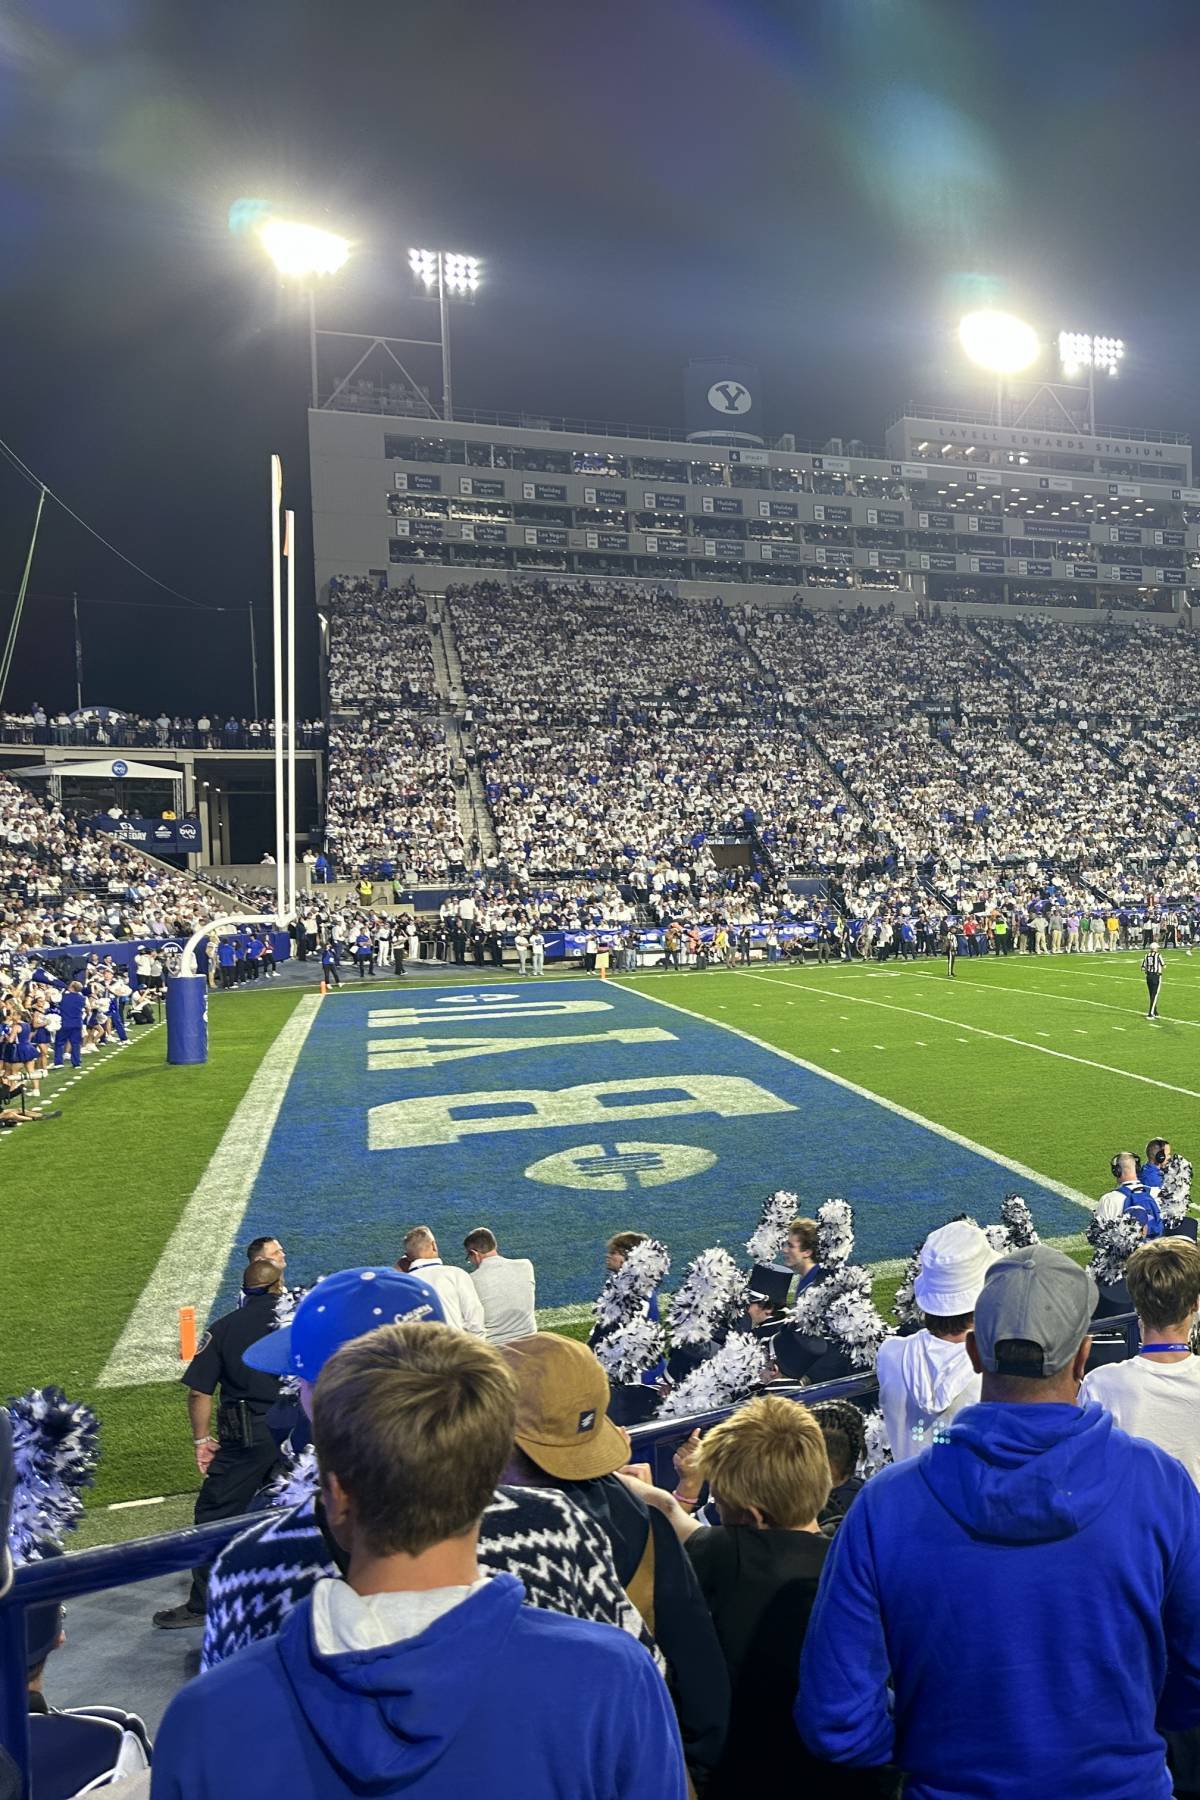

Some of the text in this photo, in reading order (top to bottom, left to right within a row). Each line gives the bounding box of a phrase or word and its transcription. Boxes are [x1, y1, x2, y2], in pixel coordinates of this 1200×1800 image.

[938, 428, 1164, 458] LAVELL EDWARDS STADIUM
[368, 1000, 800, 1151] BYU
